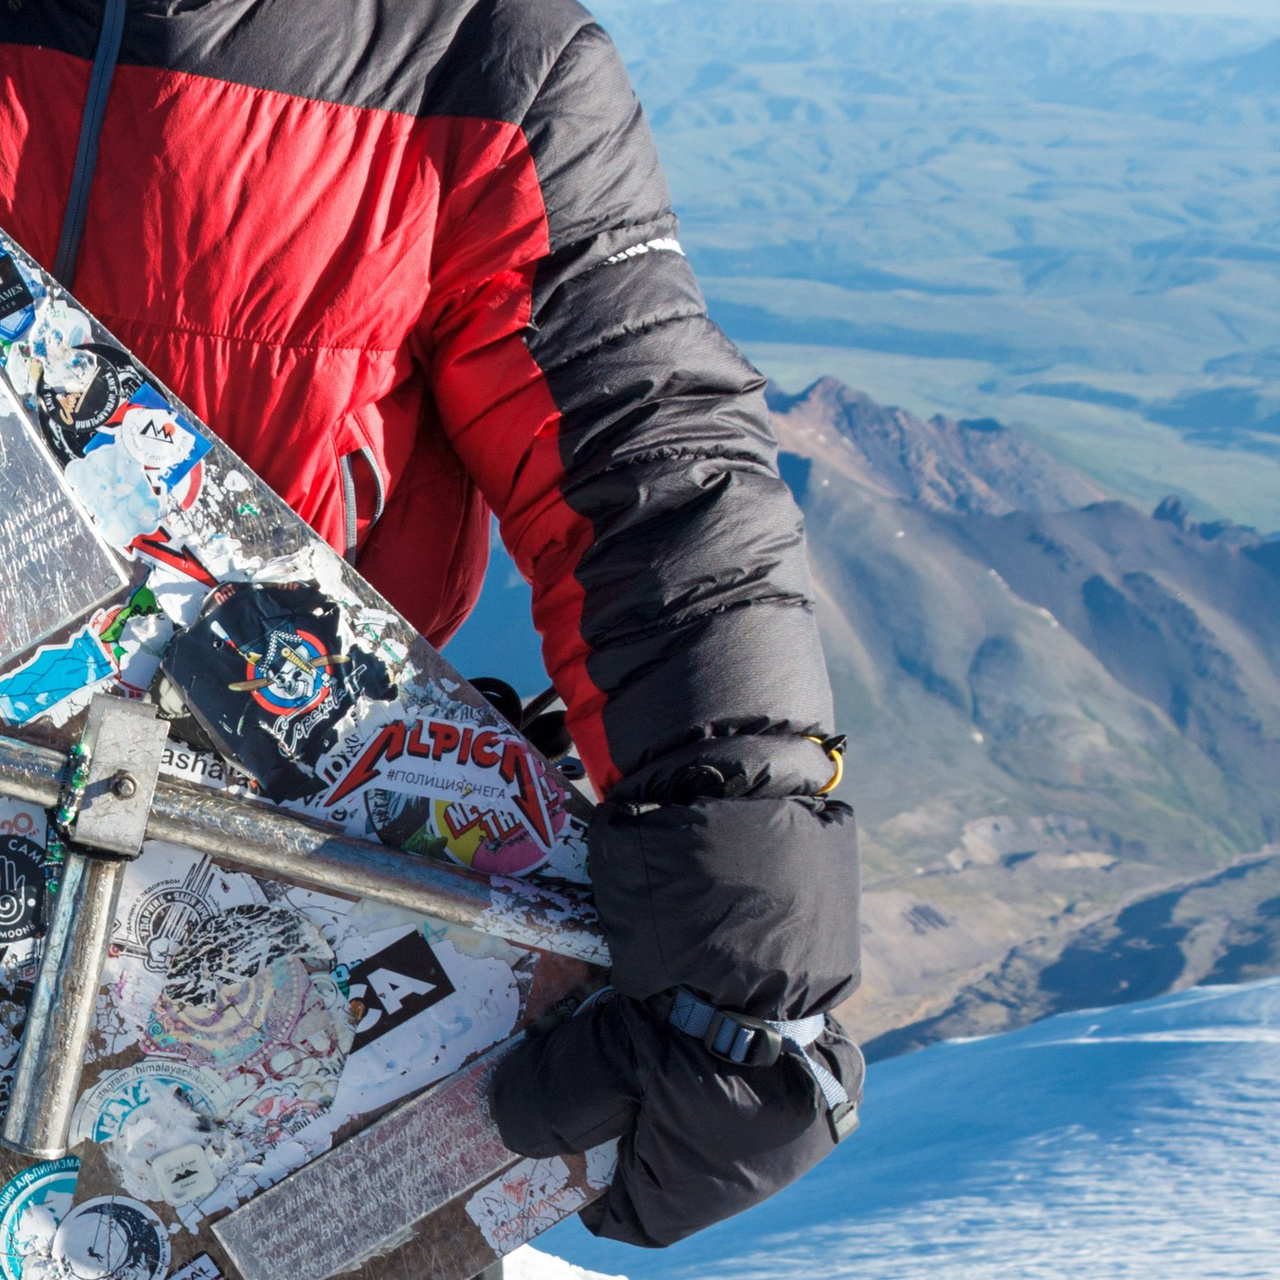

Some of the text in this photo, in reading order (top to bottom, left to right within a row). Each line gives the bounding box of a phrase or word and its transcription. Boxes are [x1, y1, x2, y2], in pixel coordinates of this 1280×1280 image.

[386, 768, 507, 800] #ПОЛИЦИЯСНЕГА
[140, 893, 168, 936] УДАРНИК
[16, 1157, 82, 1189] АЛЬПИНИЗМА
[317, 1216, 344, 1241] 55
